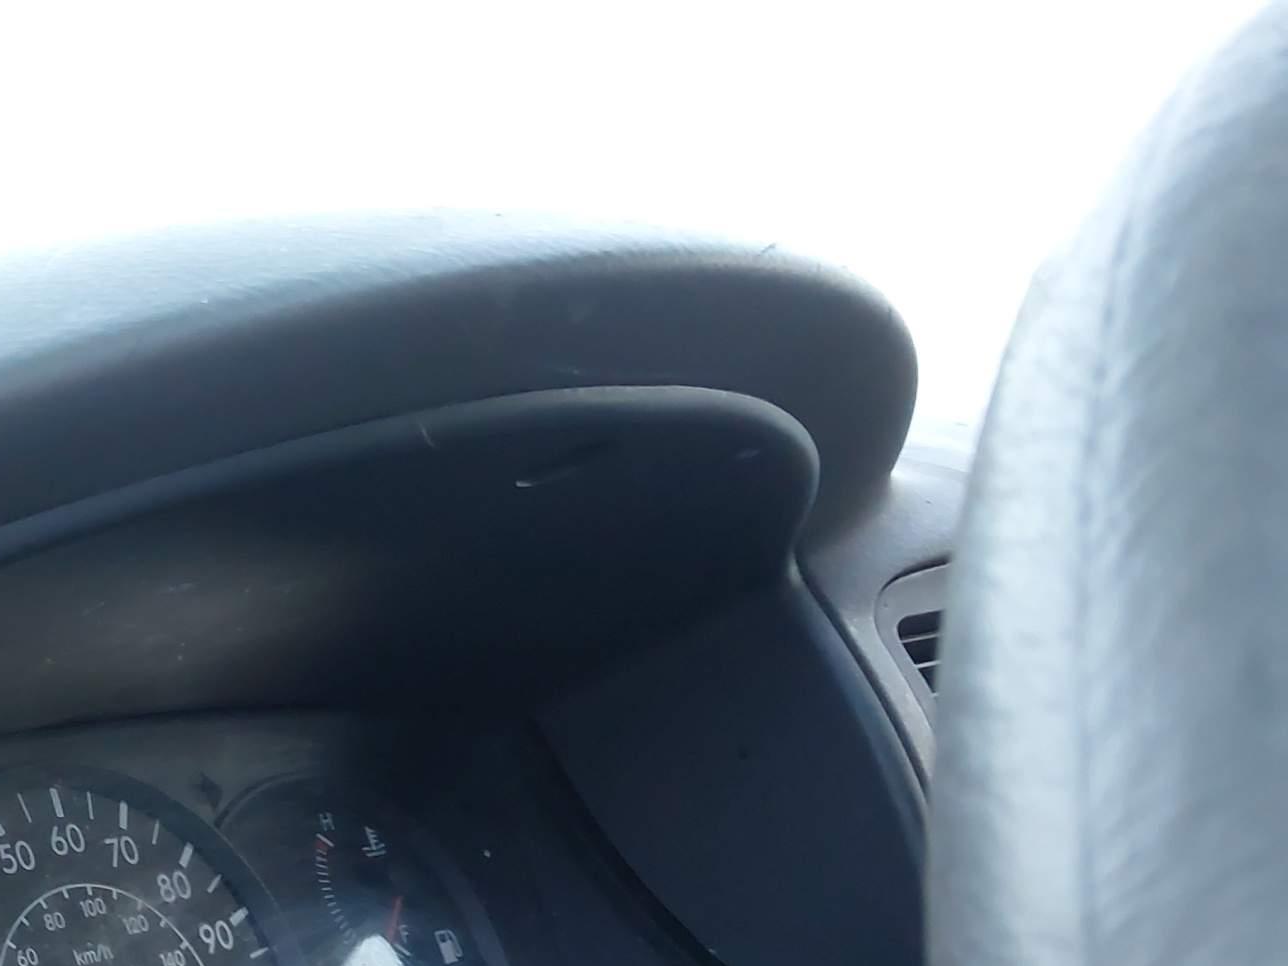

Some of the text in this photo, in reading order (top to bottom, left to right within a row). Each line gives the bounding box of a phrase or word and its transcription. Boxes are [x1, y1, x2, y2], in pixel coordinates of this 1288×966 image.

[50, 823, 86, 857] 60
[104, 836, 140, 868] 70
[0, 840, 36, 874] 50
[157, 870, 192, 903] 80
[43, 911, 66, 932] 80
[79, 897, 107, 918] 100
[124, 914, 150, 936] 120
[198, 919, 235, 954] 90
[73, 945, 114, 966] km/h
